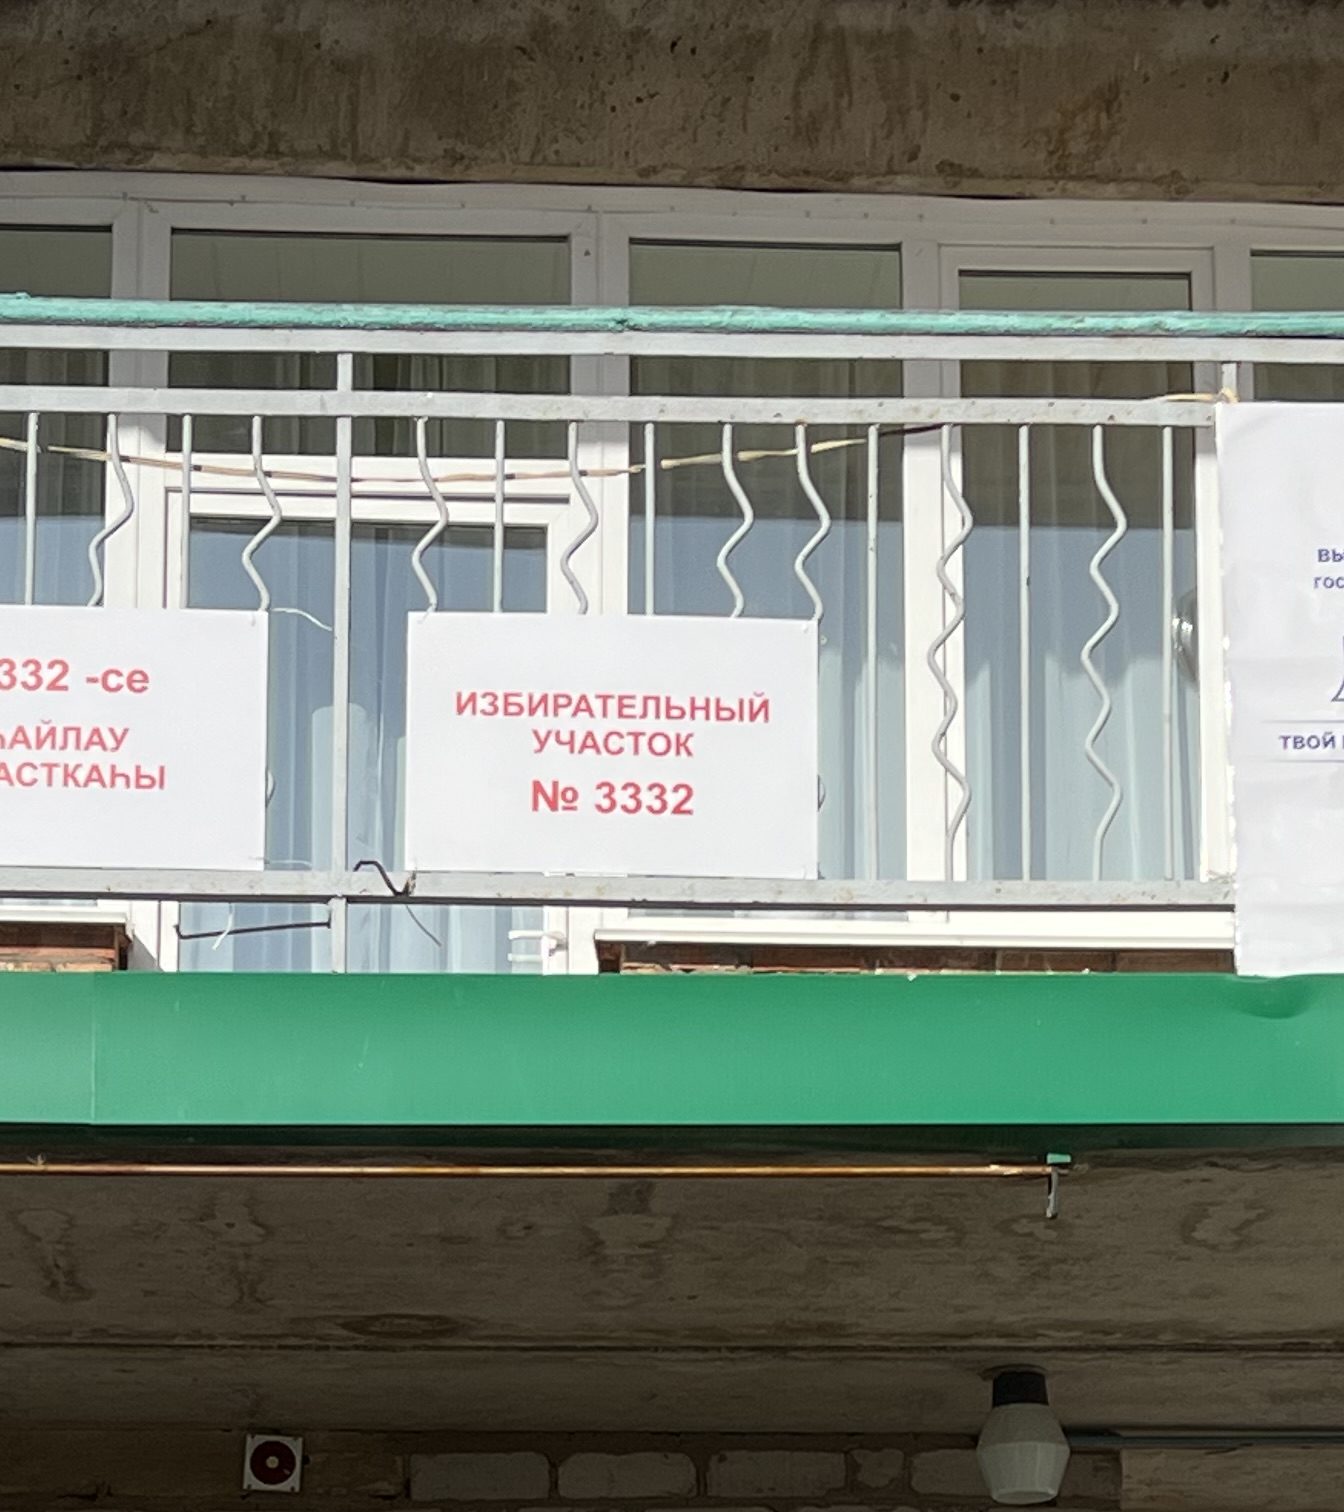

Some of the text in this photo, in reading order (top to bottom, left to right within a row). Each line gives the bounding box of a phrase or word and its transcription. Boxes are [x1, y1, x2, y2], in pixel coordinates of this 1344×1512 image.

[86, 666, 150, 694] -се
[456, 691, 770, 723] ИЗБИРАТЕЛЬНЫЙ
[532, 729, 695, 757] УЧАСТОК
[1279, 731, 1336, 750] ТВОЙ
[531, 780, 694, 815] № 3332
